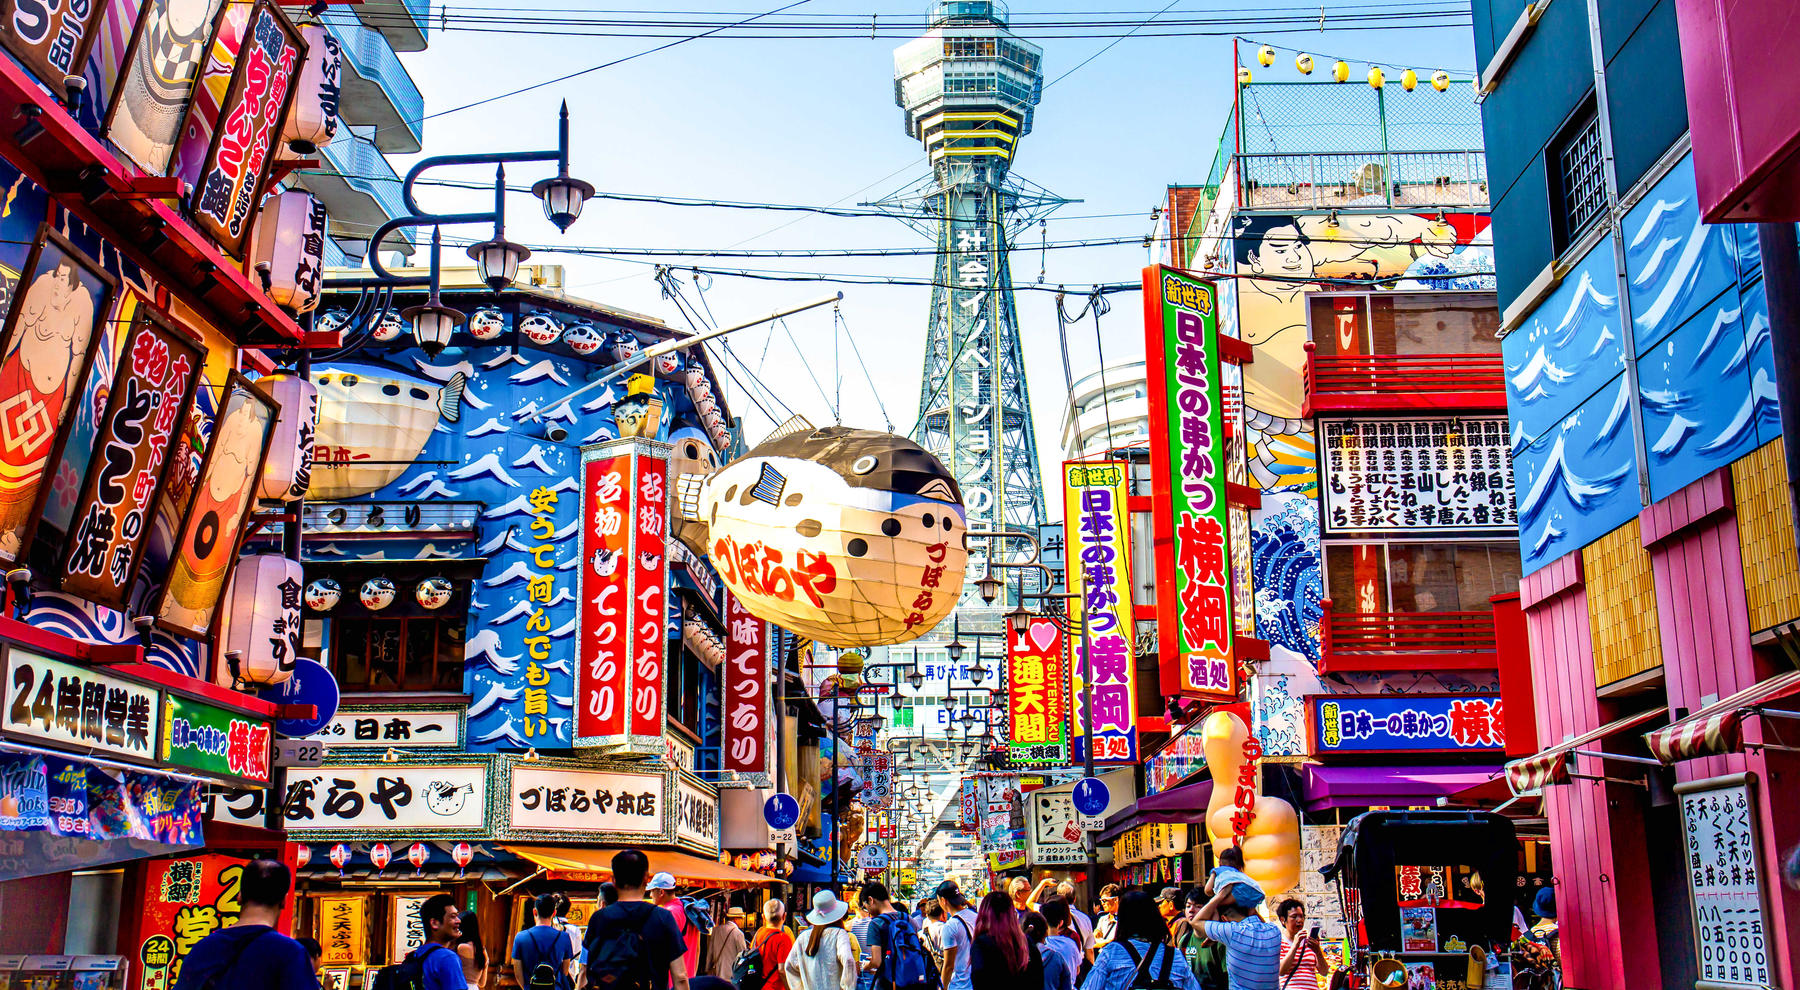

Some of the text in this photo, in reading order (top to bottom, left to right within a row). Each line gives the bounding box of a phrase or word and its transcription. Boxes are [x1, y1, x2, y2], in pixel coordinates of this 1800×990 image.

[255, 9, 284, 65] 横綱
[200, 45, 271, 228] ちゃんこ鍋
[1164, 276, 1213, 314] 新世界
[132, 330, 168, 380] 名物
[1175, 310, 1217, 515] 日本一の串かつ
[111, 355, 191, 587] 大阪下町の味
[314, 445, 371, 467] 日本一
[1069, 466, 1123, 488] 新世界
[595, 471, 623, 538] 名物
[639, 471, 664, 536] 名物
[1330, 473, 1348, 526] もち
[1347, 473, 1368, 526] うずら玉子
[1364, 473, 1385, 526] 紅しょうが
[1381, 473, 1401, 526] にんにく
[1400, 472, 1420, 526] 玉ねぎ
[1417, 472, 1436, 525] 山芋
[1435, 472, 1455, 525] しし唐
[1452, 472, 1473, 525] れんこん
[1469, 471, 1489, 525] 銀杏
[1487, 471, 1508, 524] 白ねぎ
[713, 535, 837, 609] づぼらや
[903, 541, 948, 630] づぼらや
[1080, 489, 1118, 632] 日本一の串かつ
[1177, 512, 1230, 657] 横綱
[523, 485, 559, 738] 安うて何んでも旨い
[731, 594, 761, 766] 味てっちり
[1012, 654, 1046, 744] 通天閣
[1046, 654, 1059, 742] TSUTENKAKU
[1073, 635, 1130, 734] 横綱
[1189, 655, 1230, 692] 酒処
[10, 663, 151, 751] 24時間営業
[354, 719, 442, 740] 日本一
[1324, 702, 1340, 747] 新世界
[1340, 710, 1449, 740] 日本一の串かつ
[172, 718, 227, 756] 日本一の串かつ
[227, 719, 270, 779] 横綱
[519, 786, 656, 817] づぼらや本店
[1081, 820, 1104, 829] 9-22
[770, 833, 793, 842] 9-22
[1684, 799, 1704, 888] 天ぷら盛合
[1697, 797, 1716, 887] 天丼
[1709, 796, 1729, 886] ふぐ天ぷら
[1722, 794, 1742, 886] ふぐ天丼
[1735, 792, 1756, 886] ふぐカツ丼
[146, 939, 170, 953] 24
[146, 952, 169, 965] 時間
